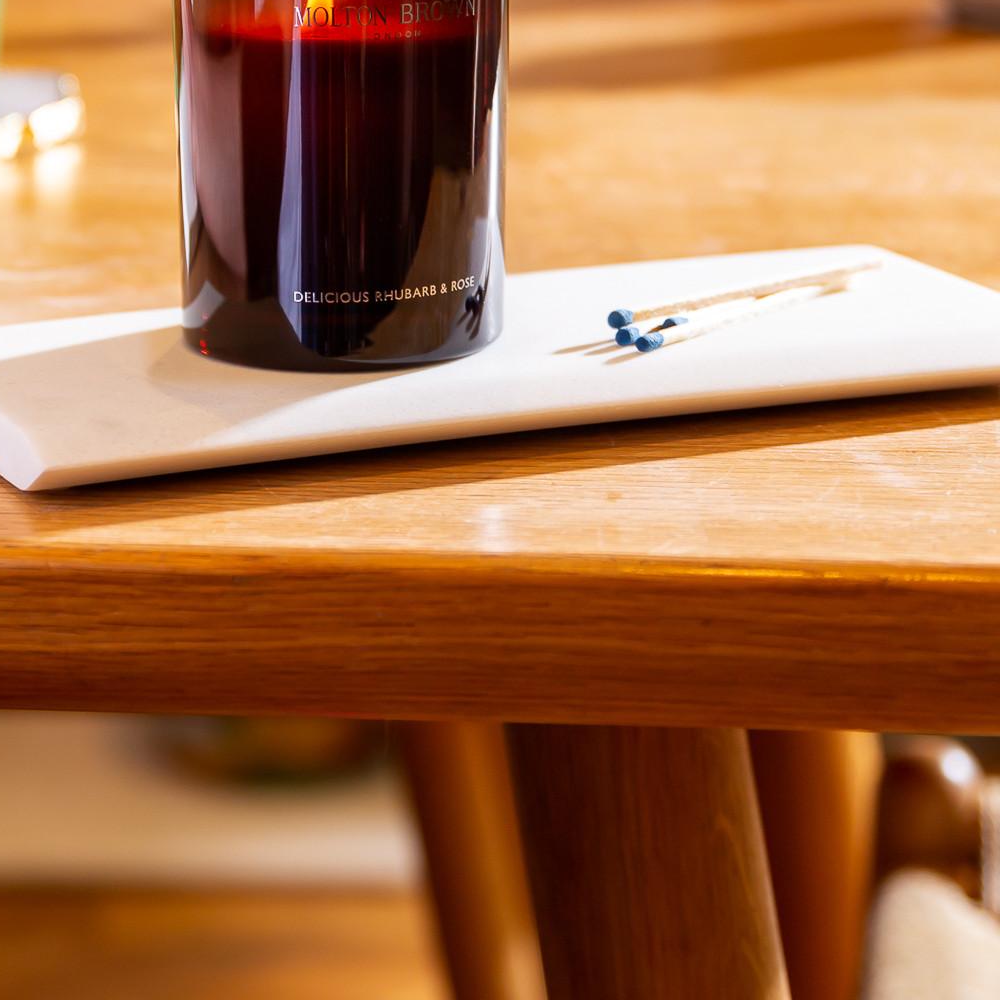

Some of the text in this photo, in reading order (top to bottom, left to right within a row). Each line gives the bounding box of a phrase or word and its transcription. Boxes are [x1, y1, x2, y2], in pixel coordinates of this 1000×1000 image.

[293, 6, 387, 27] MOLTON
[293, 275, 475, 304] DELICIOUS RHUBARB & ROSE
